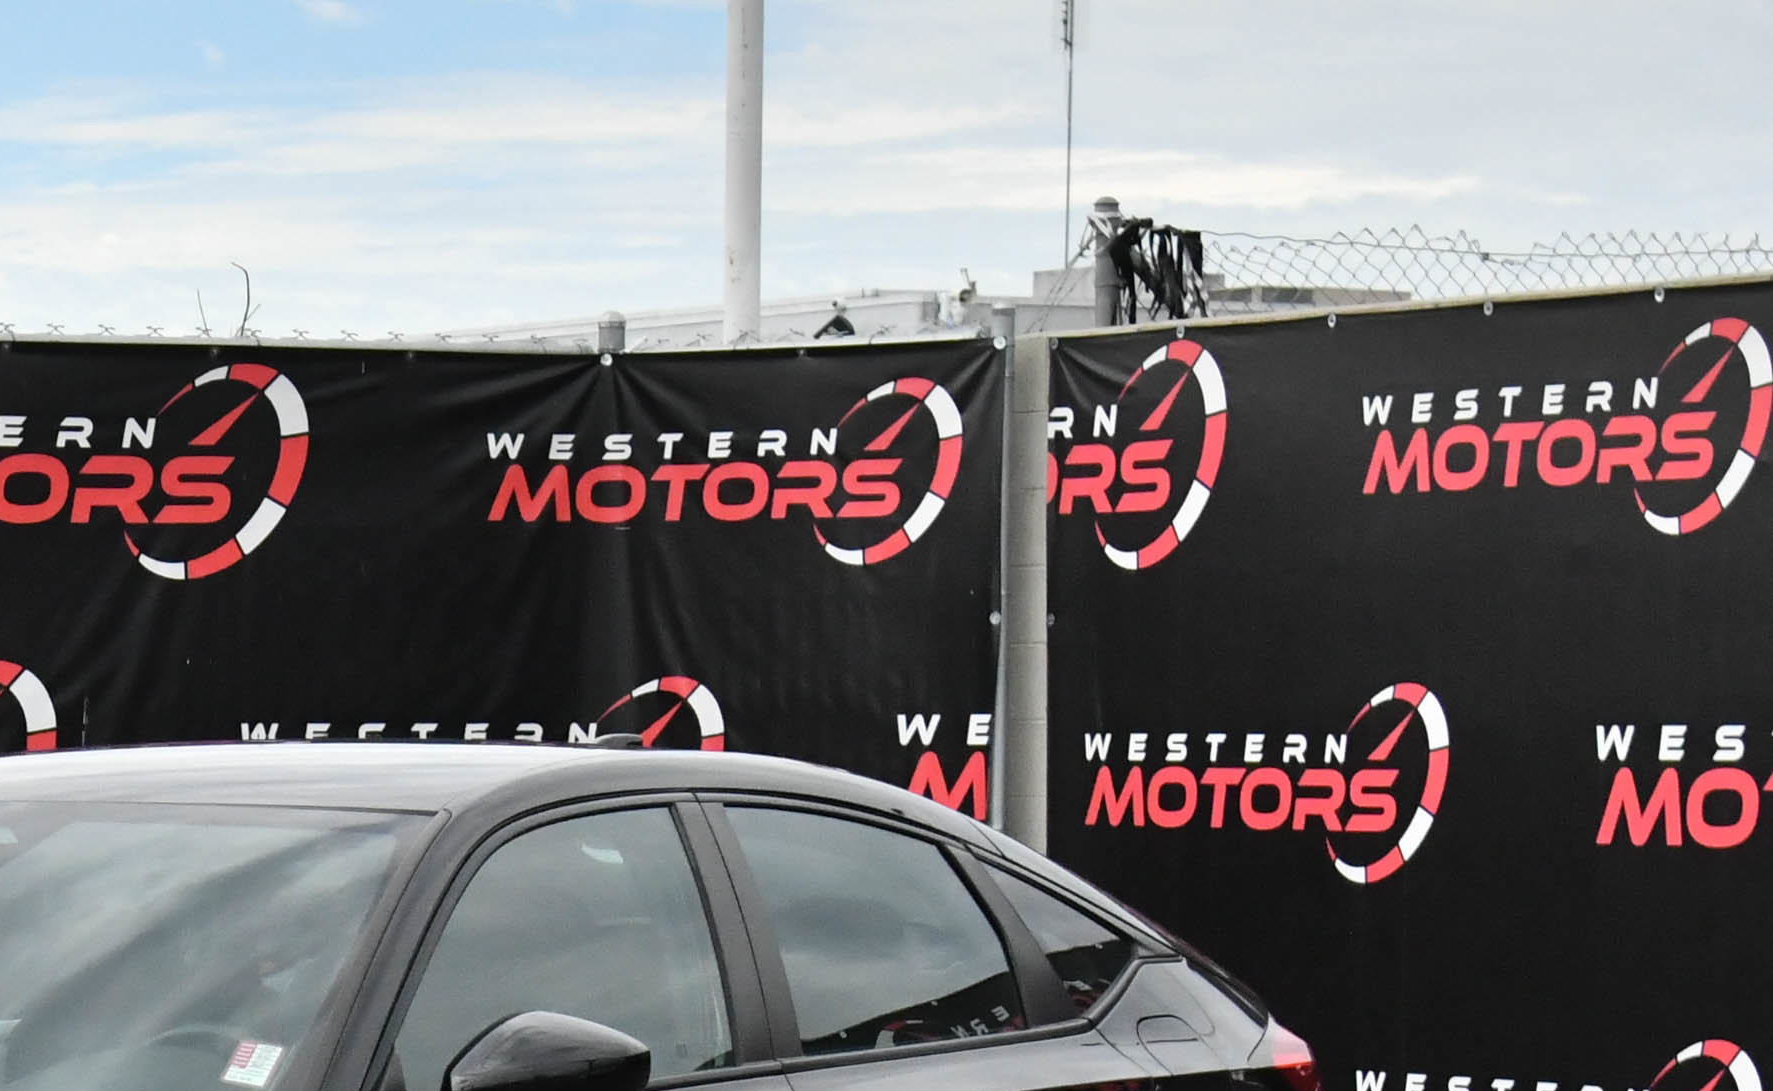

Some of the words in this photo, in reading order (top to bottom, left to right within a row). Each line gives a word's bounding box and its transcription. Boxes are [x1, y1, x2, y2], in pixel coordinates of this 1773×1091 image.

[1362, 376, 1659, 427] WESTERN
[486, 427, 838, 461] WESTERN
[1363, 410, 1717, 495] MOTORS
[488, 457, 903, 524] MOTORS
[1084, 732, 1348, 764] WESTERN
[1085, 765, 1399, 833] MOTORS
